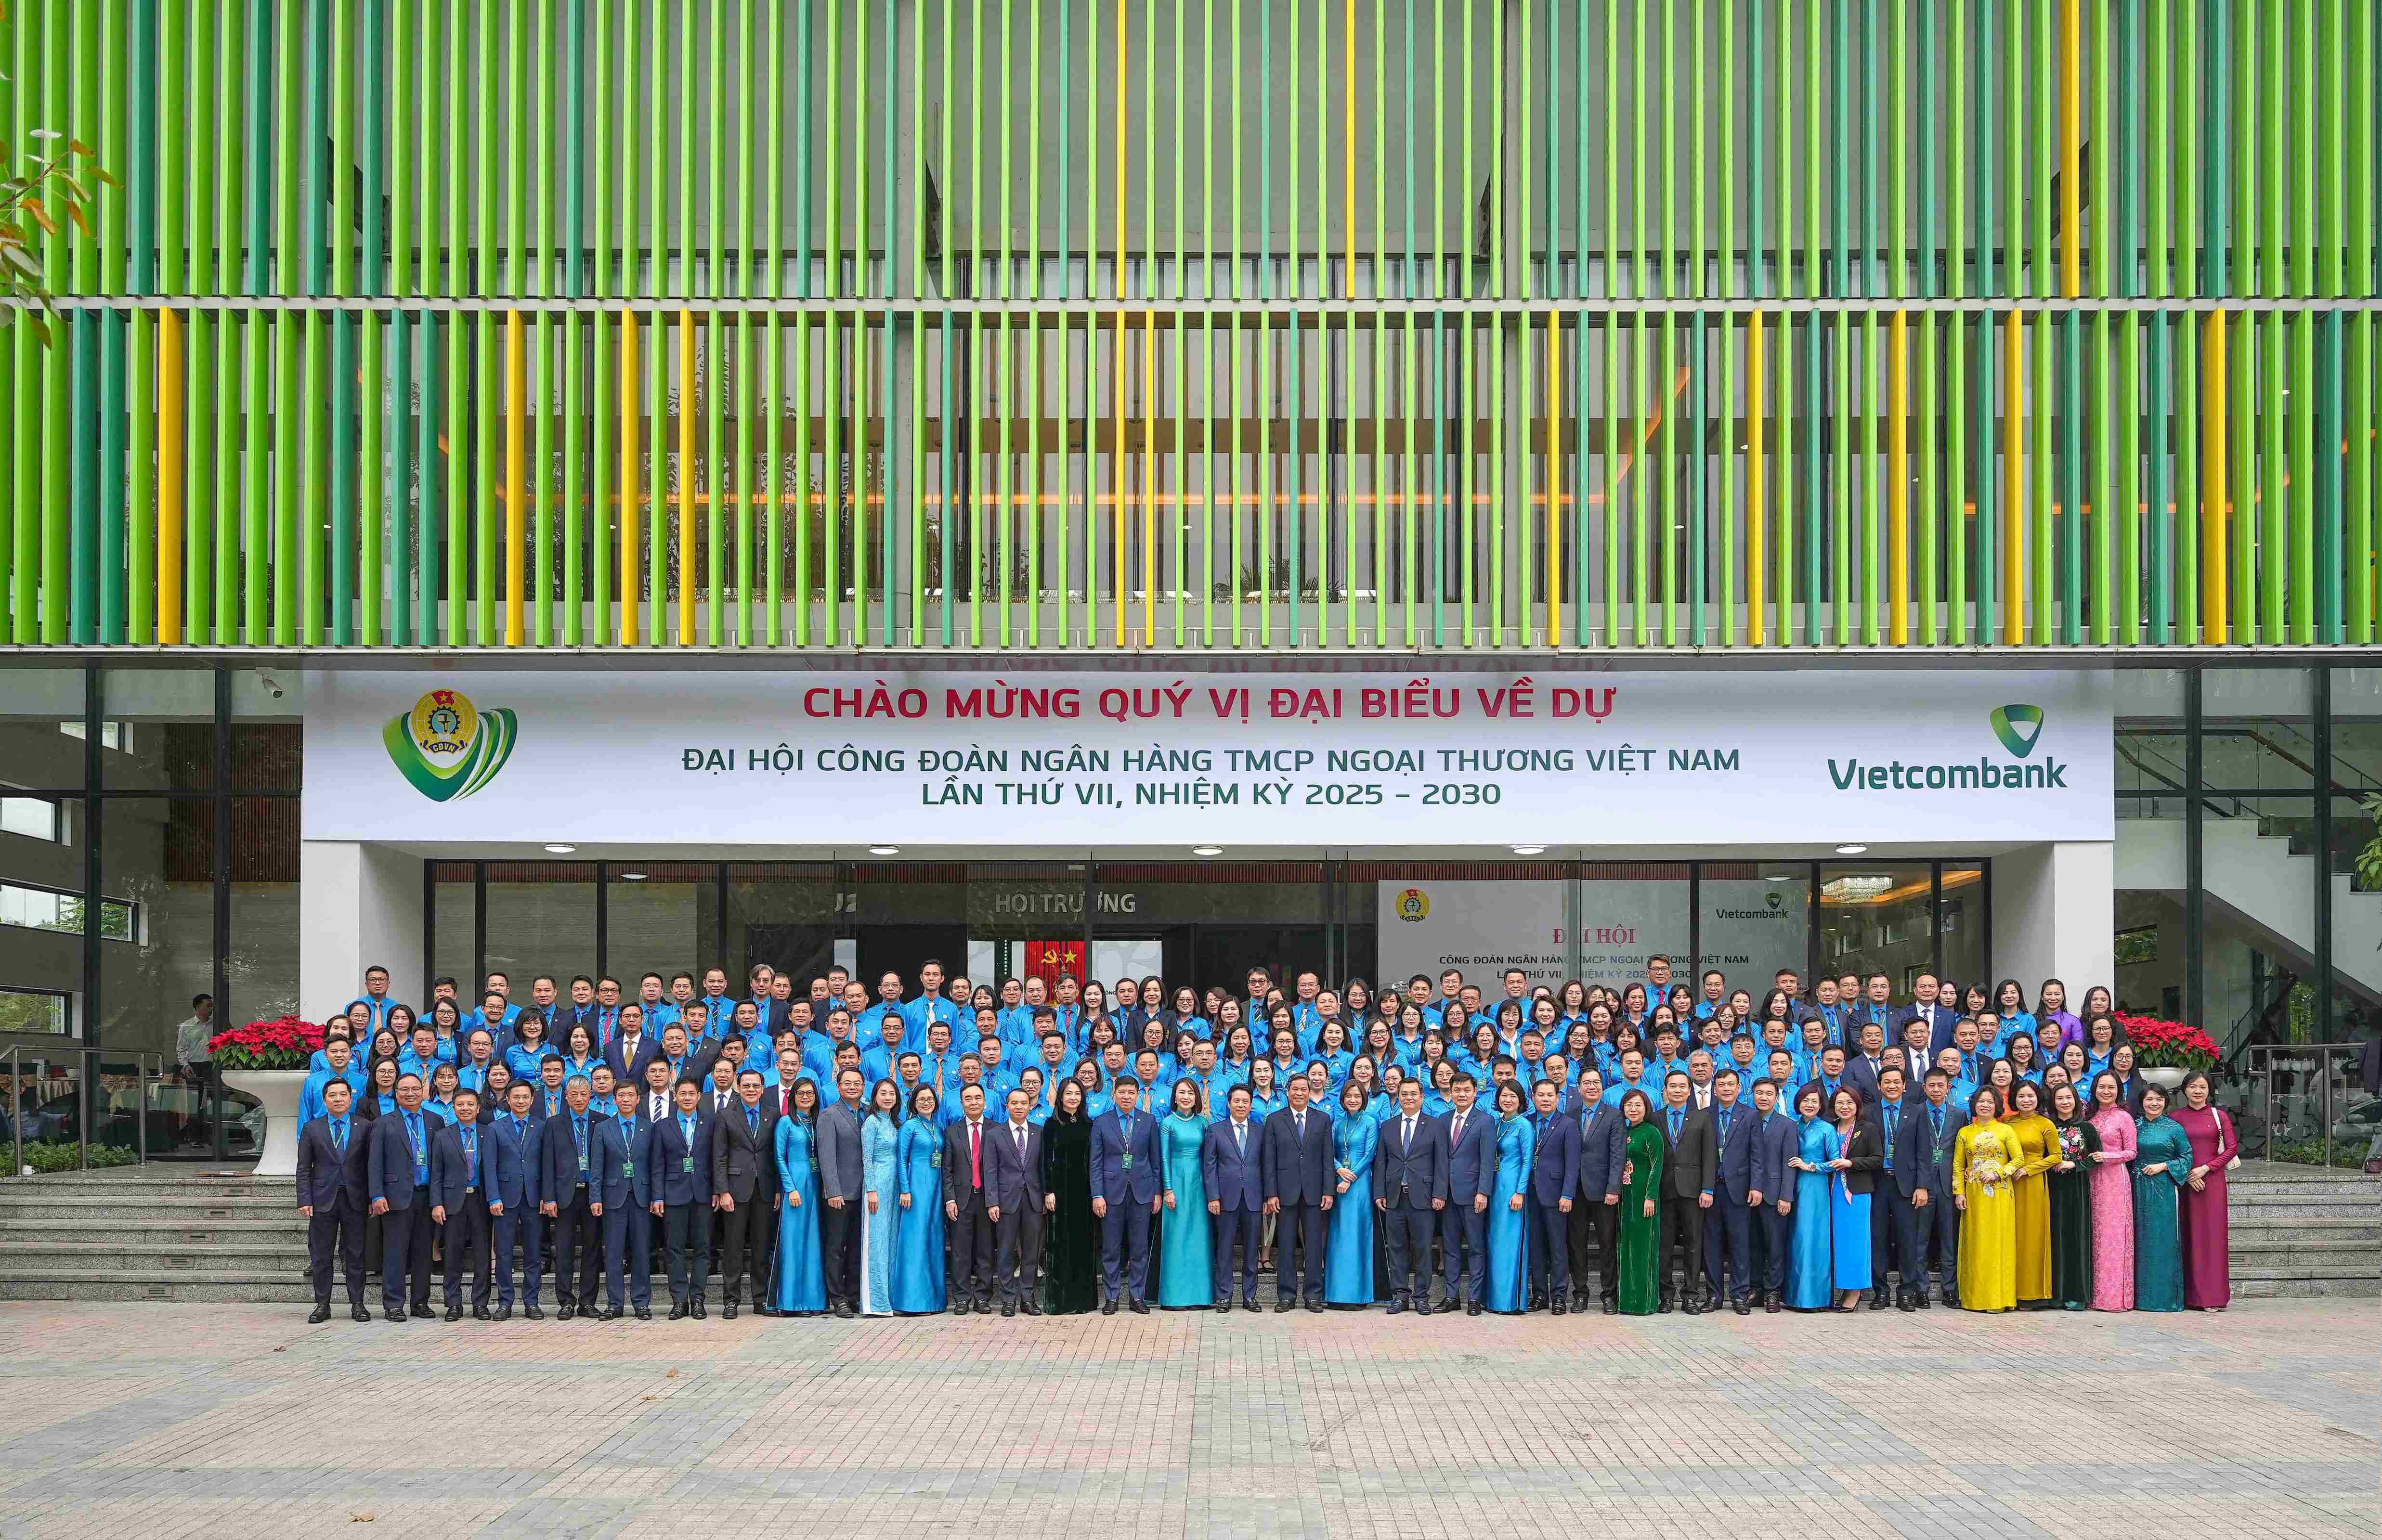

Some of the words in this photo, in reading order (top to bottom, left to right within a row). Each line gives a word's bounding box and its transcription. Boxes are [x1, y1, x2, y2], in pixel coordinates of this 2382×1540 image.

[804, 679, 928, 719] CHÀO
[946, 679, 1080, 719] MỪNG
[1098, 679, 1193, 723] QUÝ
[1209, 687, 1249, 724] VỊ
[1267, 687, 1342, 724] ĐẠI
[1361, 677, 1461, 718] BIỂU
[1477, 676, 1534, 717] VỀ
[1551, 686, 1617, 724] DỰ
[681, 749, 734, 775] ĐẠI
[749, 742, 803, 776] HỘI
[817, 743, 905, 772] CÔNG
[917, 743, 1007, 772] ĐOÀN
[1021, 743, 1109, 772] NGÂN
[1123, 743, 1211, 772] HÀNG
[1224, 750, 1314, 772] TMCP
[1328, 750, 1424, 776] NGOẠI
[1436, 749, 1574, 771] THƯƠNG
[1586, 743, 1657, 776] VIỆT
[1669, 749, 1739, 771] NAM
[1828, 756, 2068, 790] Vietcombank
[923, 775, 983, 805] LẦN
[995, 777, 1064, 805] THỨ
[1074, 783, 1122, 809] VII,
[1136, 776, 1238, 809] NHIỆM
[1253, 776, 1294, 805] KỲ
[1306, 784, 1383, 805] 2025
[1422, 784, 1501, 804] 2030
[1040, 891, 1135, 913] TRƯNG
[1716, 908, 1789, 919] Vietcombank
[1552, 929, 1591, 944] ĐI
[1595, 924, 1636, 948] HỘI
[1439, 954, 1469, 964] CÔNG
[1473, 954, 1504, 964] ĐOÀN
[1508, 954, 1538, 964] NGÂN
[1610, 955, 1643, 965] NGOẠI
